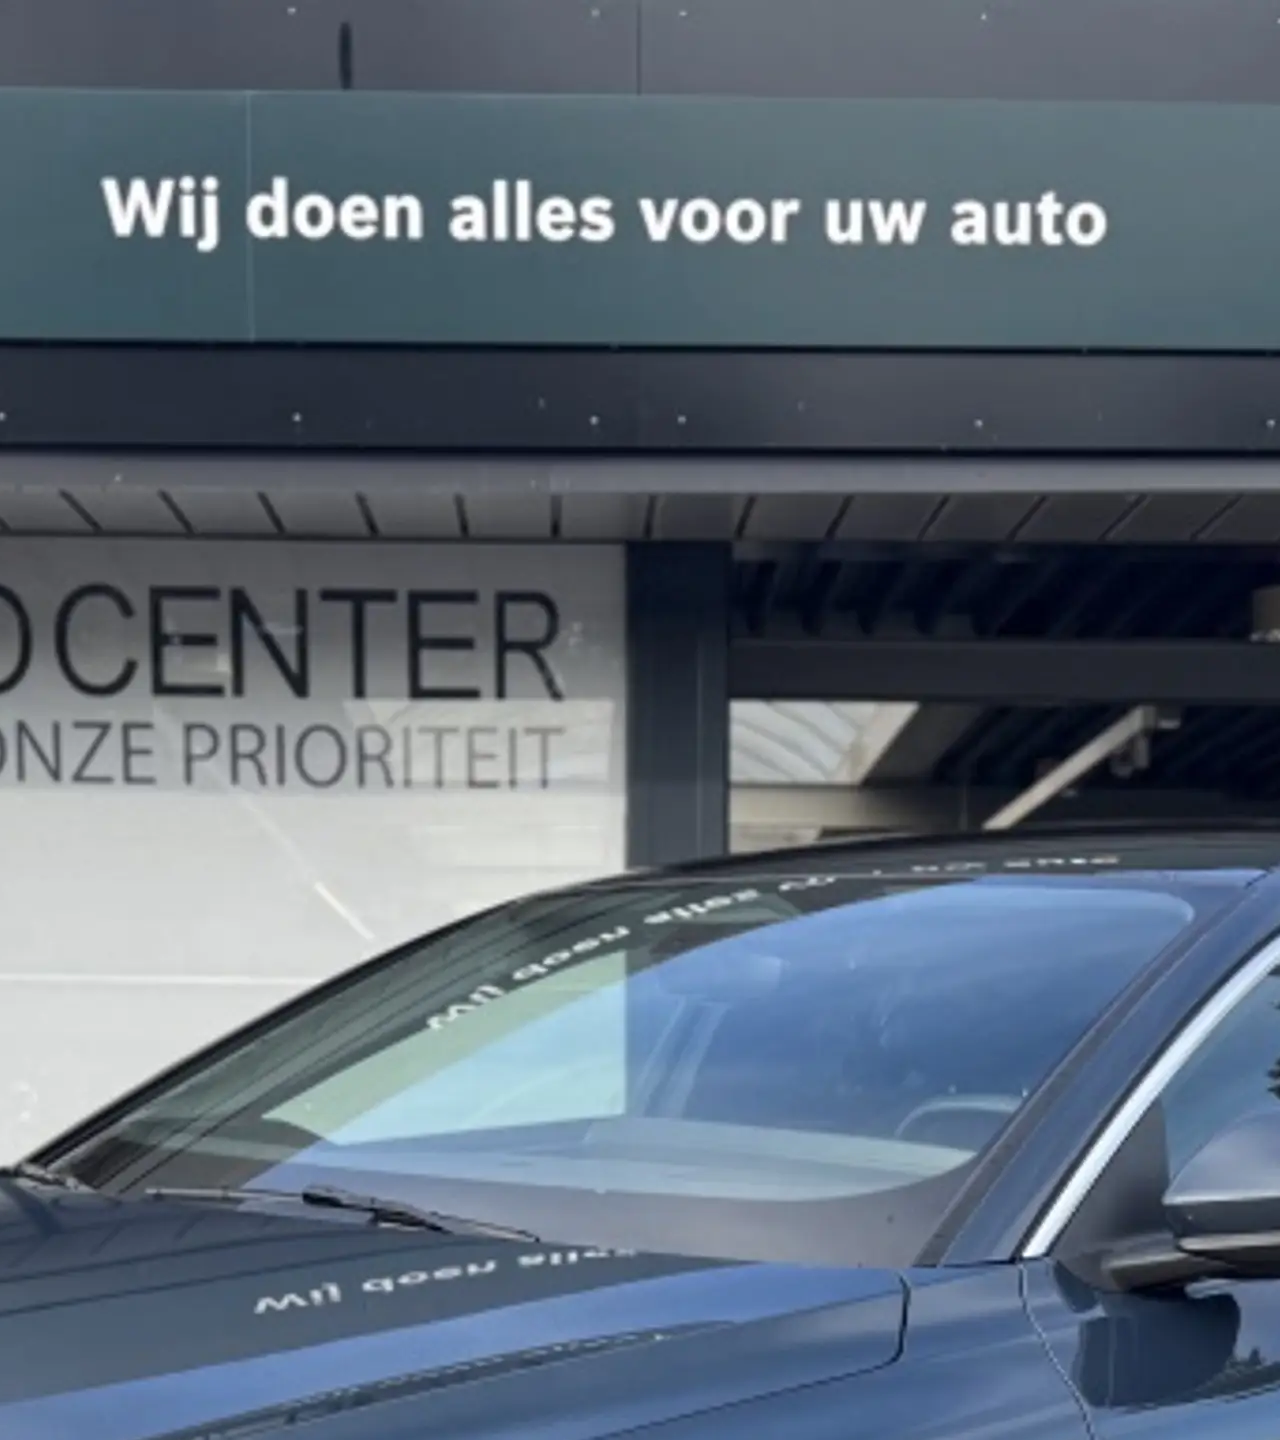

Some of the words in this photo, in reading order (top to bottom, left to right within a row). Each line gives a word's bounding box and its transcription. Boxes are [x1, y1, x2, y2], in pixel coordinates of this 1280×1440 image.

[103, 176, 219, 252] Wij
[247, 177, 423, 240] doen
[450, 180, 616, 243] alles
[640, 199, 801, 244] voor
[827, 200, 928, 245] uw
[952, 192, 1108, 247] auto
[182, 721, 567, 790] PRIORITEIT
